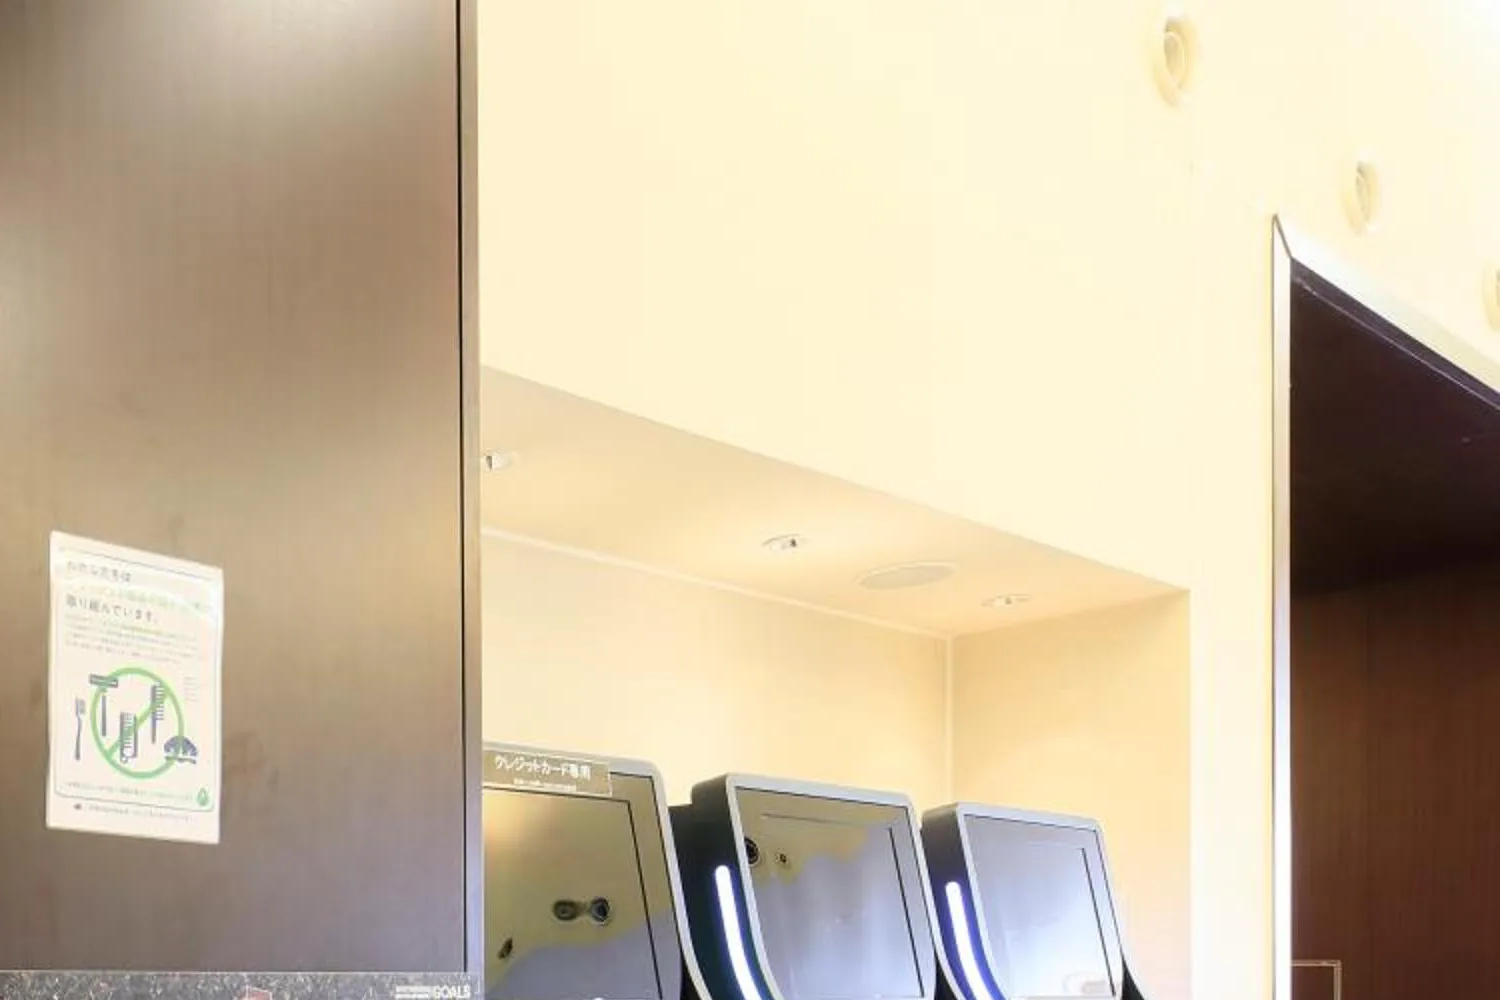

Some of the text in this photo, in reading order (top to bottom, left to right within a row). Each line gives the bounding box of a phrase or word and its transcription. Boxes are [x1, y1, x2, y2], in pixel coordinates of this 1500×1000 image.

[495, 753, 591, 782] クレジットカード専用
